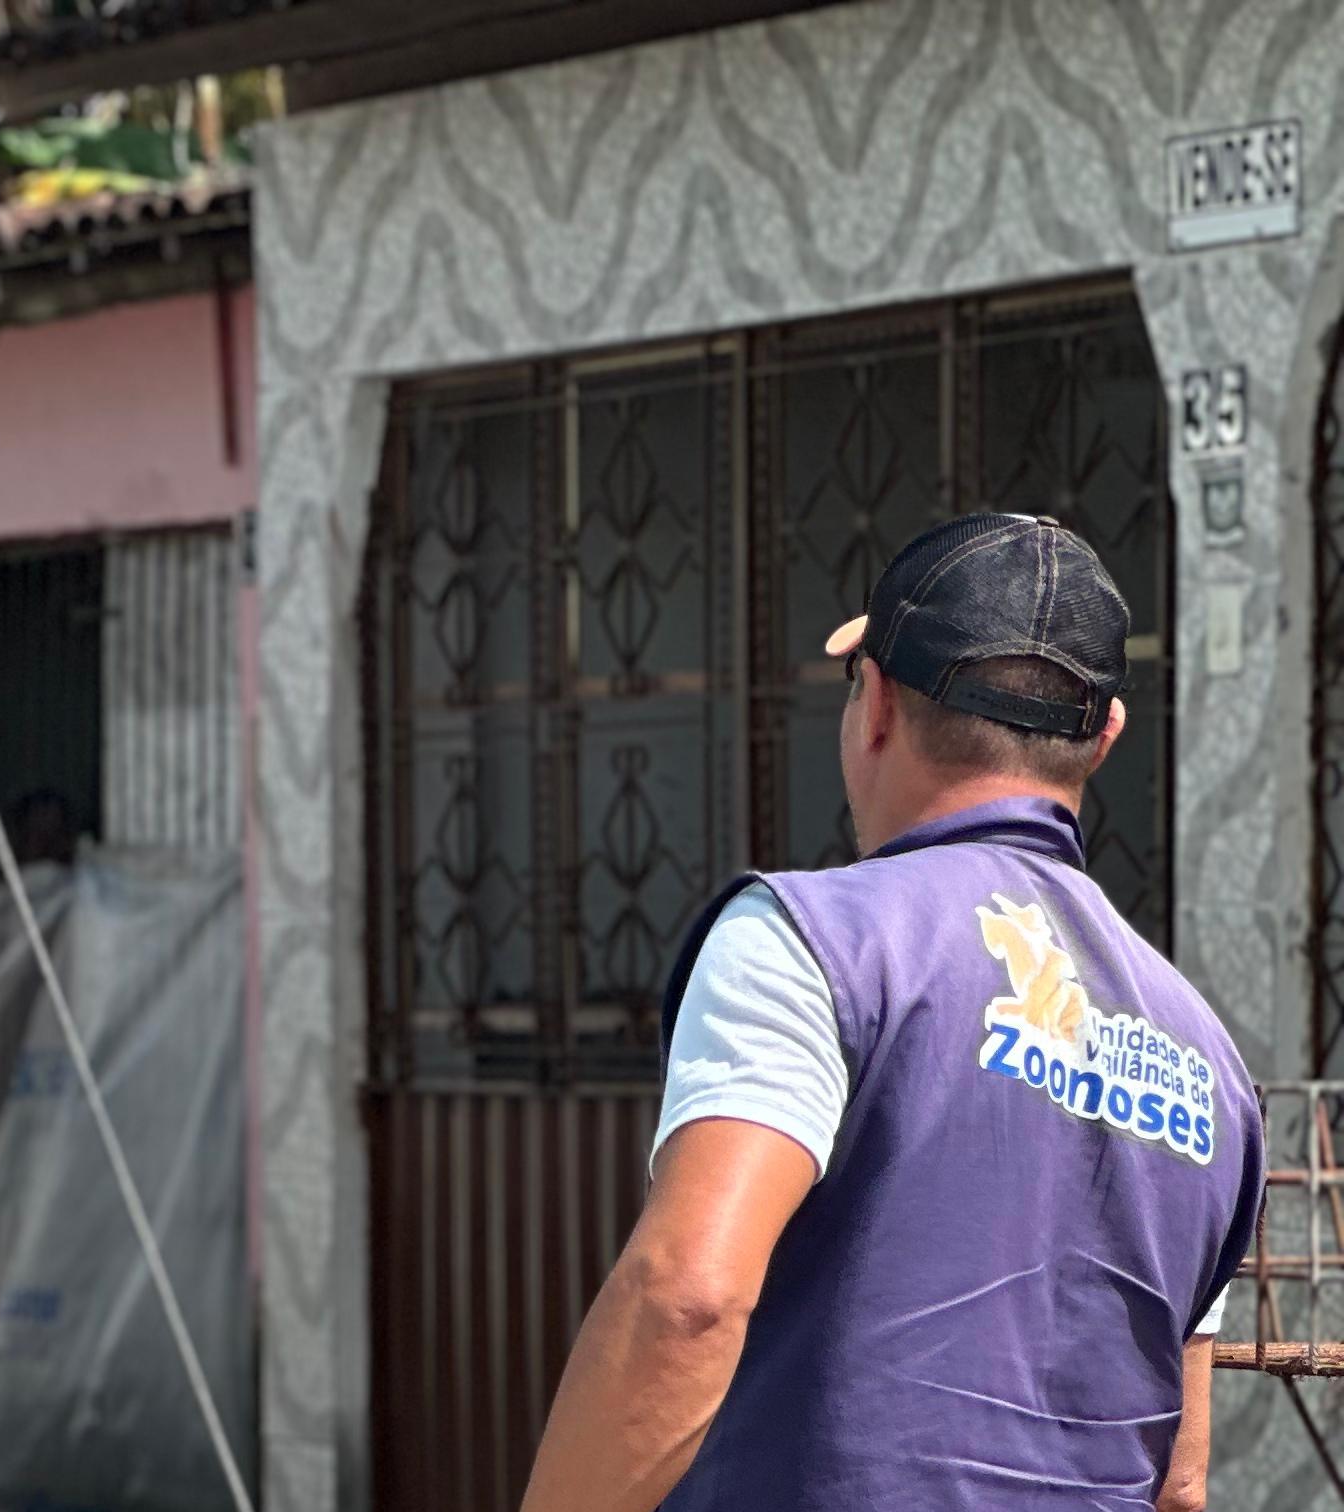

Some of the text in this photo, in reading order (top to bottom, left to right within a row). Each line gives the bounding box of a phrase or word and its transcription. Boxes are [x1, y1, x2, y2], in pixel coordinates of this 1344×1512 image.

[1172, 131, 1293, 209] VENDE-SE
[1184, 371, 1244, 448] 35
[1086, 1040, 1210, 1111] Vgilância de
[1092, 1016, 1209, 1084] nidade de
[986, 1022, 1211, 1156] Zoonoses
